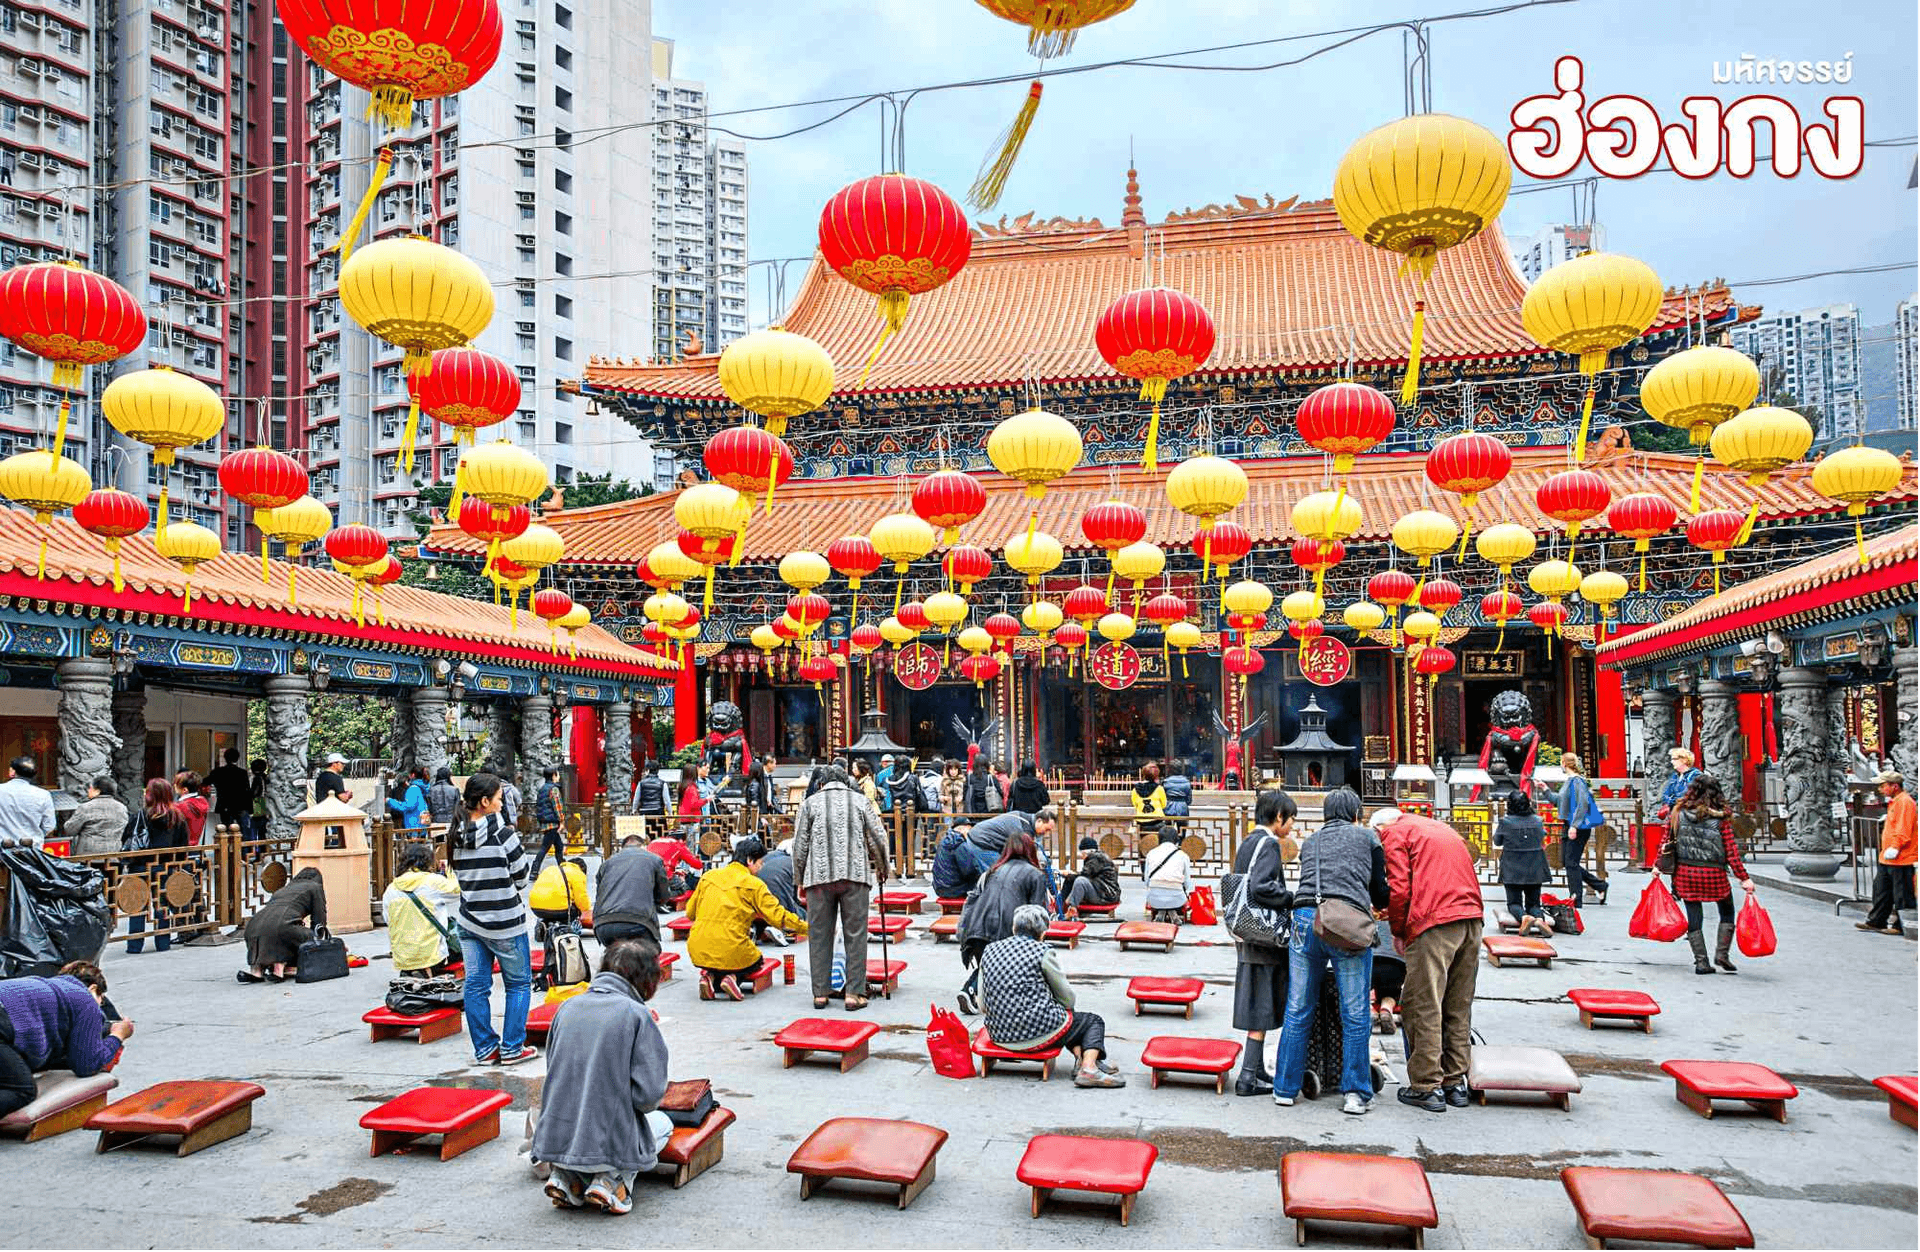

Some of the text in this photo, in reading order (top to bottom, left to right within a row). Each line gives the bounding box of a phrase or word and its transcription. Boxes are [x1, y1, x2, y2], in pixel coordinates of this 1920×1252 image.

[905, 653, 929, 679] 師
[1101, 650, 1130, 681] 道
[1309, 648, 1337, 673] 經
